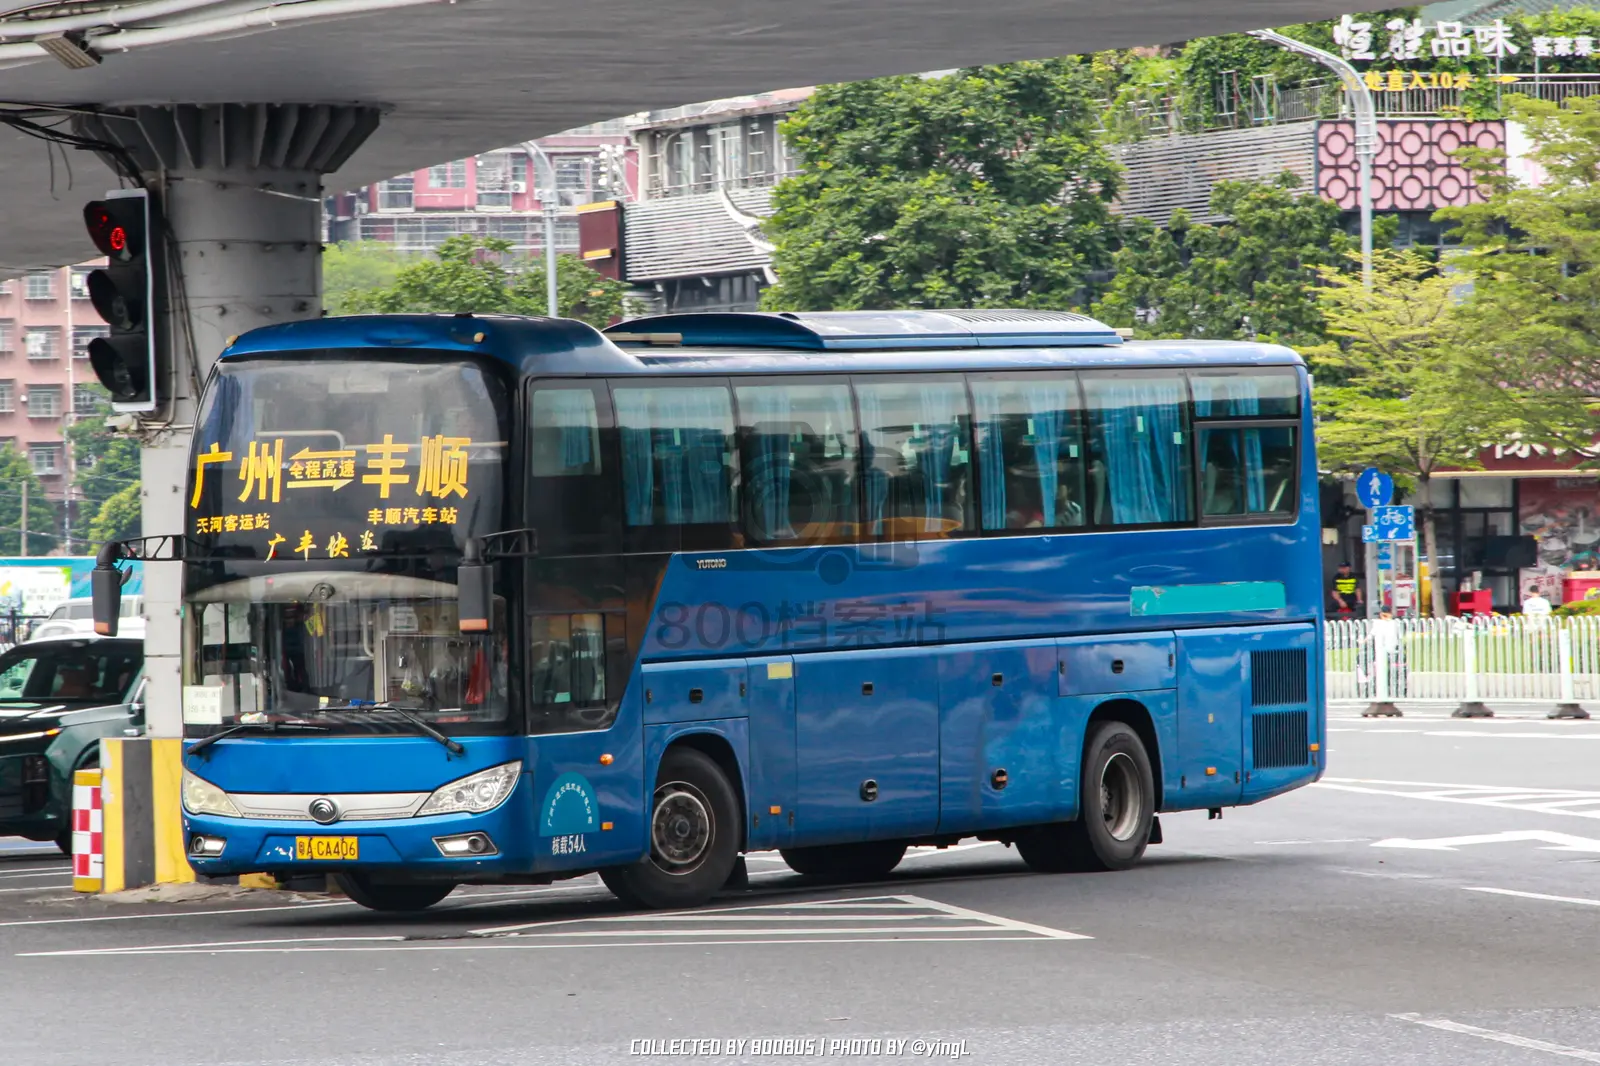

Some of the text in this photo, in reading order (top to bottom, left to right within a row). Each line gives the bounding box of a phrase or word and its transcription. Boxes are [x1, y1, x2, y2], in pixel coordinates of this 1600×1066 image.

[191, 438, 283, 508] 广州
[289, 459, 355, 479] 全程高速
[362, 434, 471, 498] 丰顺
[196, 513, 271, 534] 天河客运站
[367, 507, 458, 525] 丰顺汽车站
[696, 558, 727, 569] YUTONG
[552, 833, 586, 856] 核载54人
